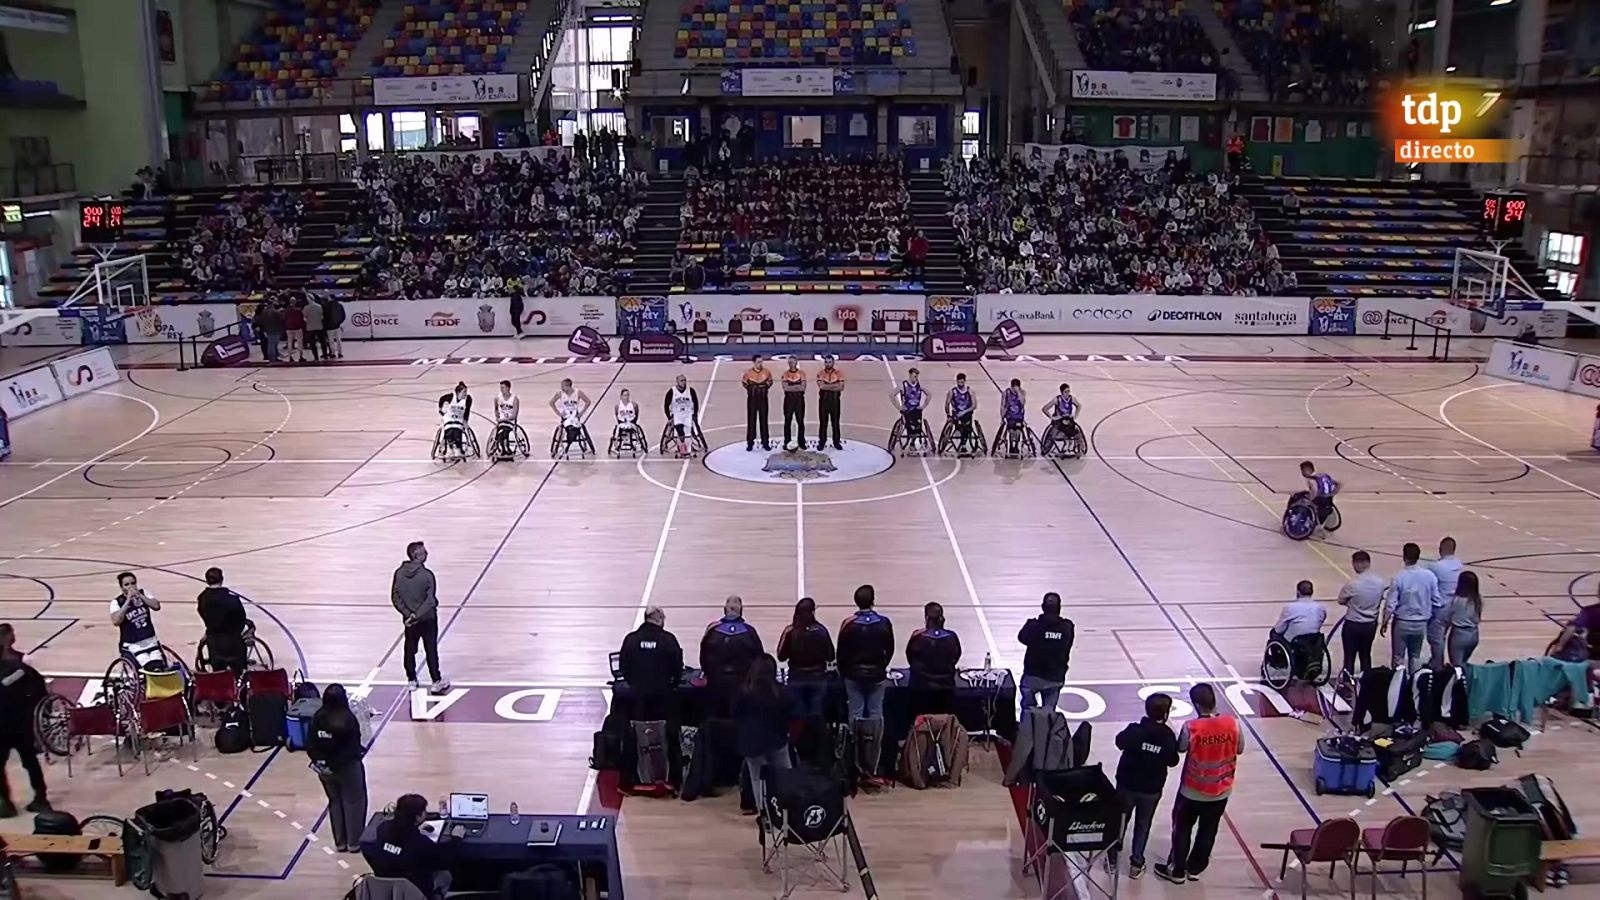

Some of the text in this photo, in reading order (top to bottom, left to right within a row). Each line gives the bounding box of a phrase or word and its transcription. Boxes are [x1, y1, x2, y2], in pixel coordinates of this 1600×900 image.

[1484, 207, 1496, 219] 24
[1504, 209, 1524, 222] 24
[83, 215, 100, 228] 24
[111, 214, 121, 227] 24
[934, 304, 961, 313] COPA
[1317, 305, 1342, 314] COPA
[642, 312, 660, 320] REY
[1010, 310, 1056, 320] CaixaBank
[1072, 308, 1133, 320] endesa
[1163, 311, 1222, 321] DECATHLON
[1333, 312, 1350, 321] REY
[373, 318, 400, 326] ONCE
[1045, 631, 1062, 641] STAFF
[1196, 734, 1233, 746] PRENSA
[1142, 742, 1162, 754] STAFF
